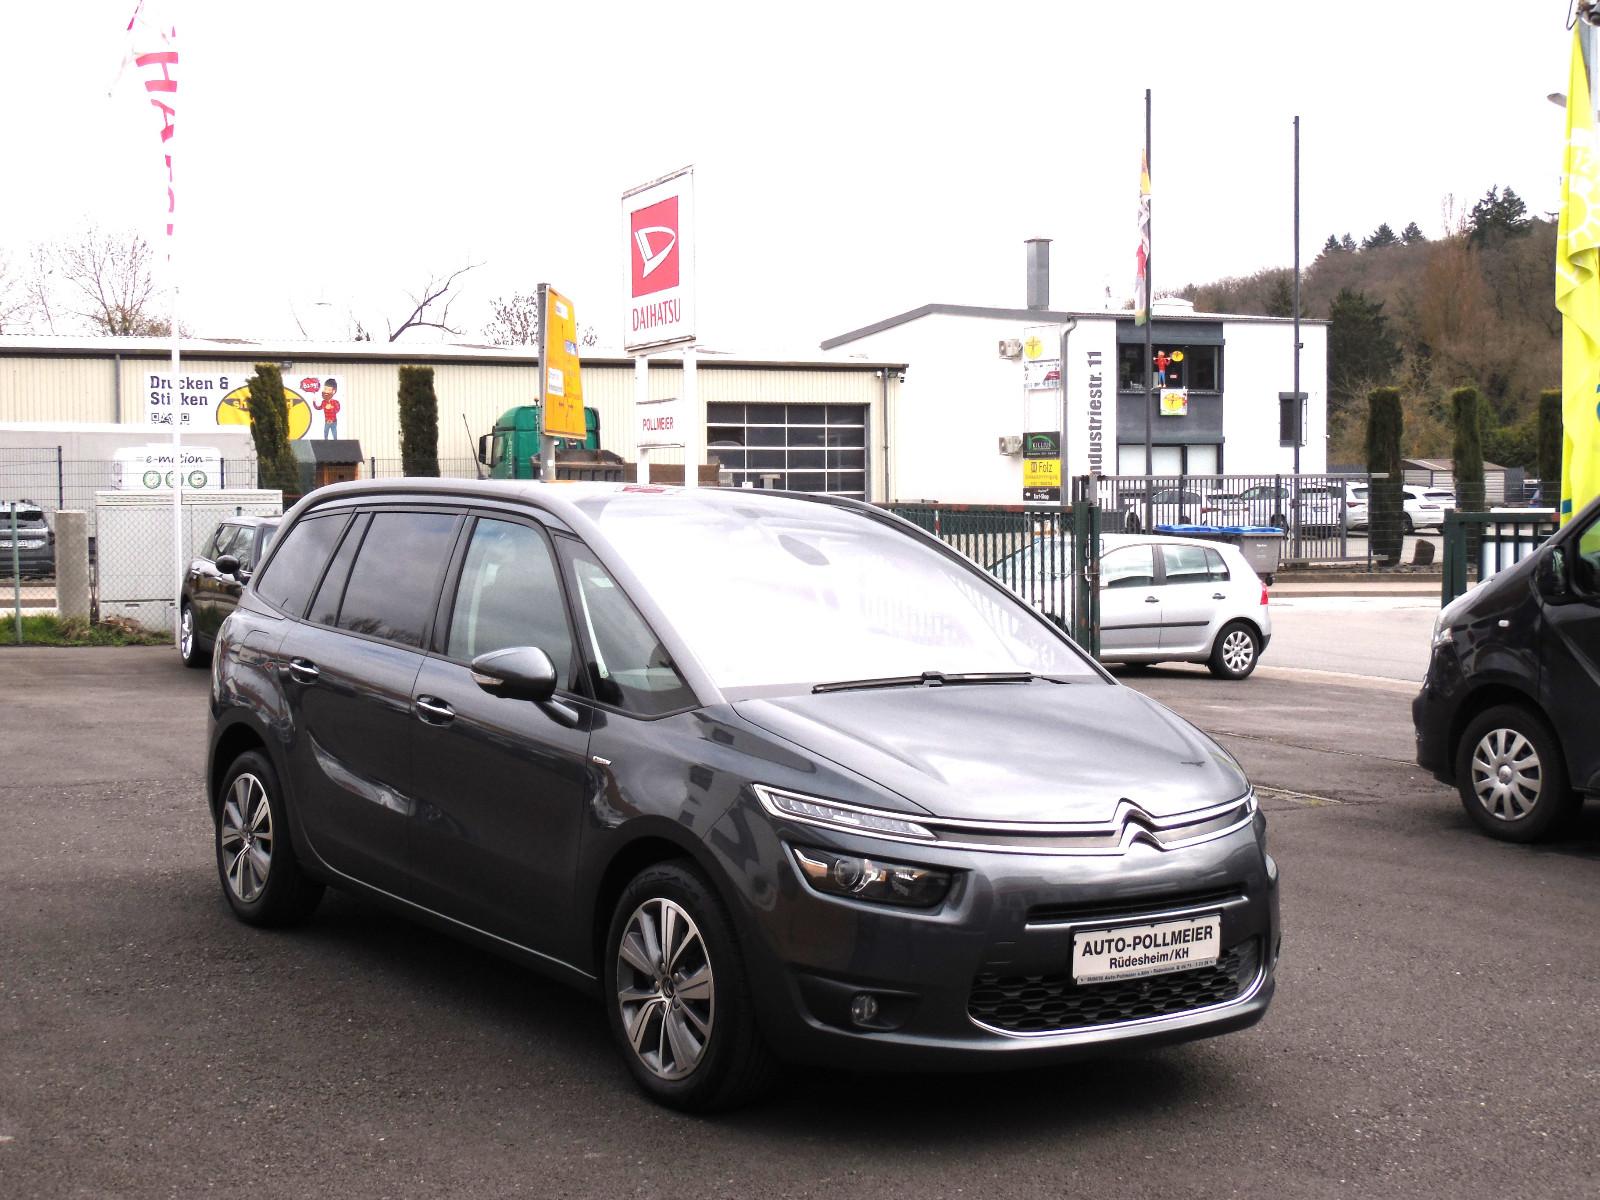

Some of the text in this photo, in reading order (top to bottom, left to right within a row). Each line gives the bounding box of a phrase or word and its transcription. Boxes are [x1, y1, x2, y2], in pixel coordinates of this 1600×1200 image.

[632, 298, 681, 332] DAIHATSU
[219, 376, 230, 390] &
[150, 391, 208, 406] Stiken
[1086, 351, 1103, 475] ndustriestr. 11
[642, 416, 674, 431] POLLMEIER
[146, 453, 204, 464] e-mtion
[1038, 461, 1053, 473] Folz
[1082, 925, 1213, 957] AUTO-POLLMEIER
[1109, 946, 1190, 970] Rüdesheim/KH
